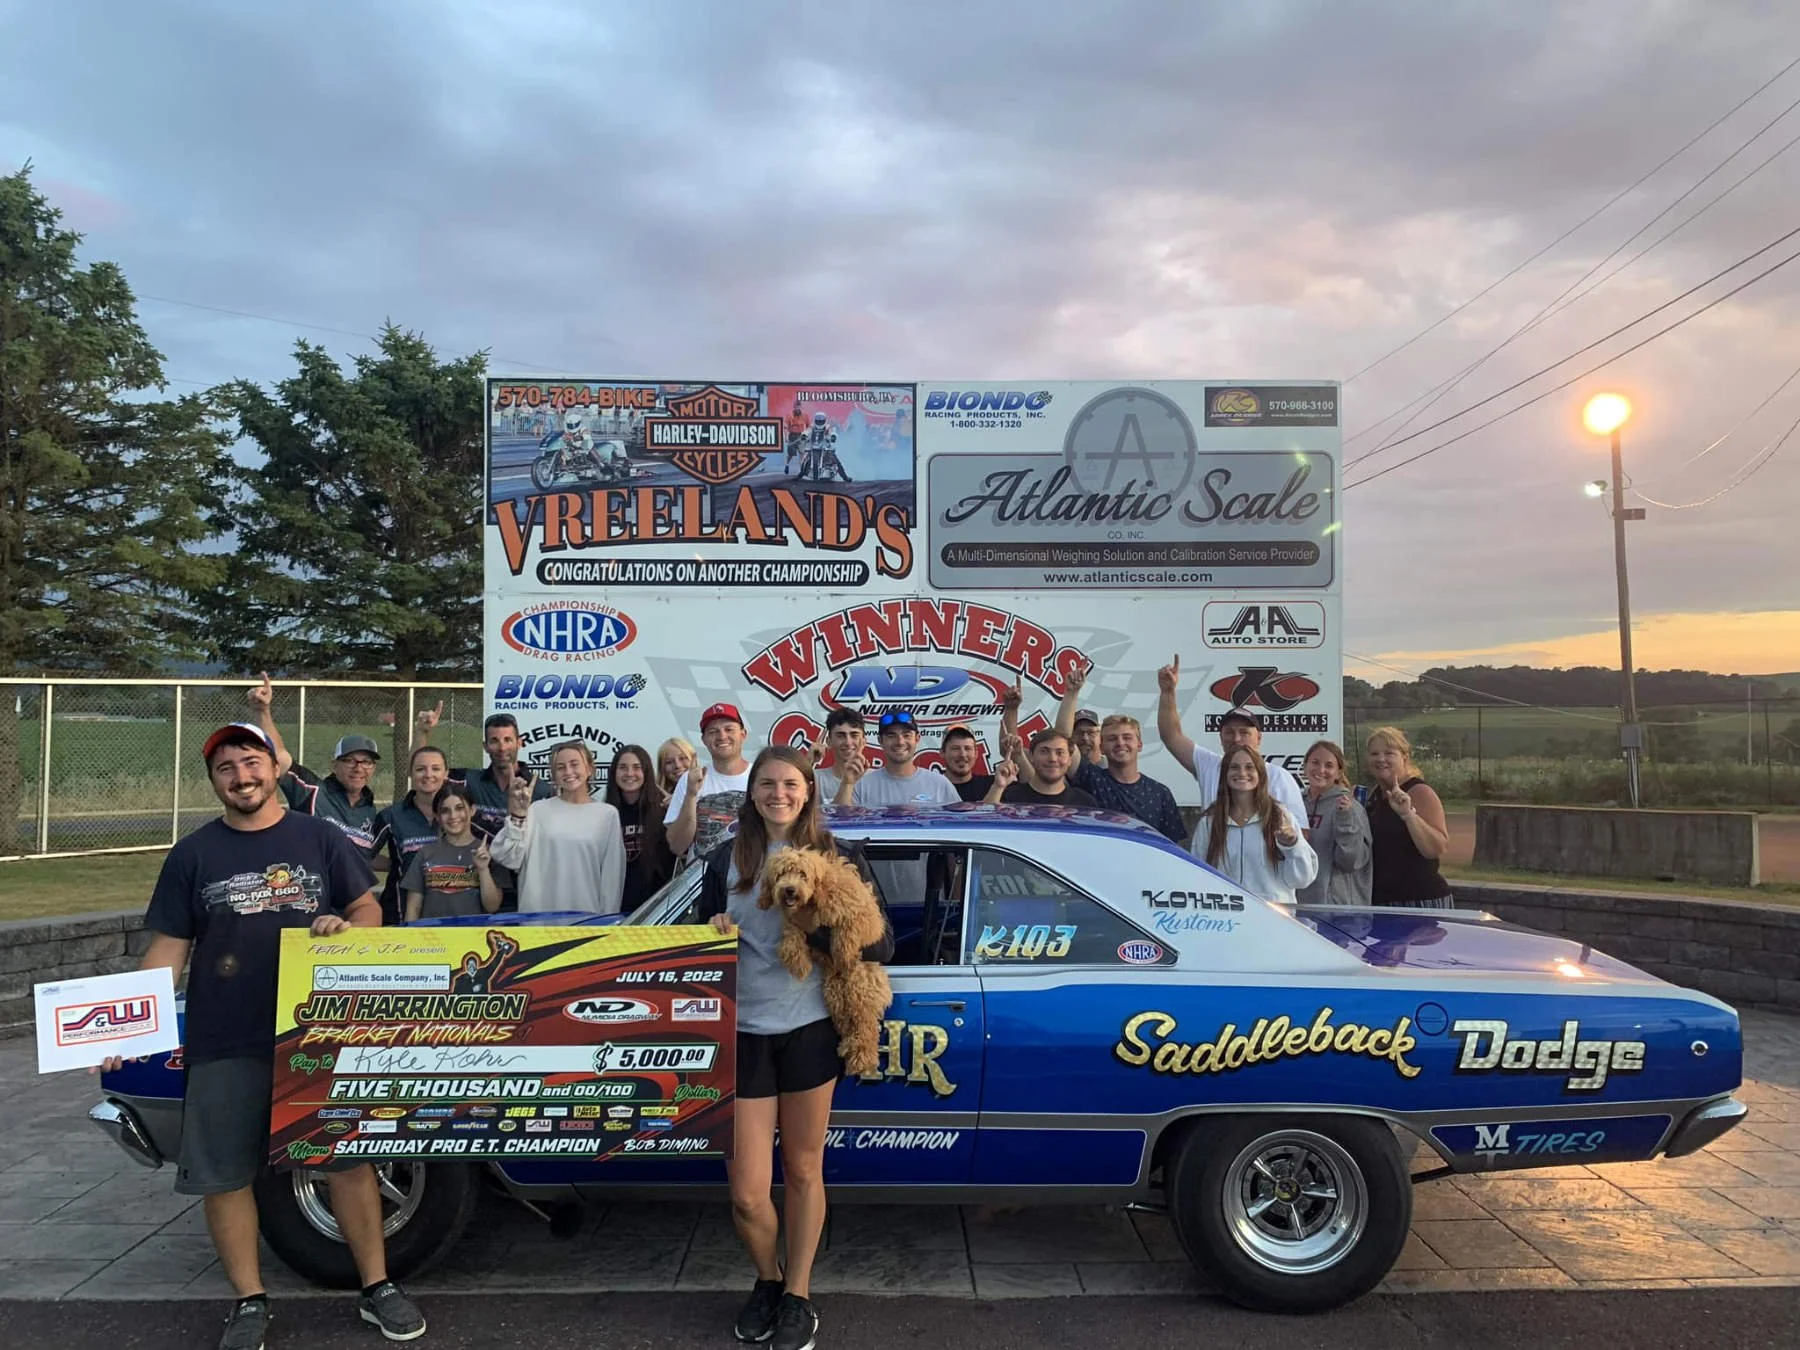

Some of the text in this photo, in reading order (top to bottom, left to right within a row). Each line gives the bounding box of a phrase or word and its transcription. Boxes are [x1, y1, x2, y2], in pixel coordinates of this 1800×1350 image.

[498, 385, 657, 409] 570-784-BIKE
[679, 395, 746, 417] MOTOR
[924, 391, 1048, 411] BIONDO
[924, 411, 1046, 420] RACING PRODUCTS, INC.
[949, 420, 1022, 429] 1-800-332-1320
[652, 424, 777, 445] HARLEY-DAVIDSON
[682, 450, 750, 478] CYCLES
[944, 463, 1321, 524] Atlantic Scale
[491, 484, 915, 580] VREELAND'S
[947, 549, 1315, 564] A Multi-Dimensional Weighing Solution and Calibration Service Provider
[544, 561, 863, 583] CONGRATULATIONS ON ANOTHER CHAMPIONSHIP
[1043, 569, 1214, 584] www.atlanticscale.com
[522, 600, 618, 618] CHAMPIONSHIP
[523, 612, 619, 650] NHRA
[1211, 636, 1308, 645] AUTO STORE
[522, 647, 616, 662] DRAG RACING
[742, 597, 1095, 702] WINNERS
[494, 674, 639, 700] BIONDO
[494, 701, 640, 712] RACING PRODUCTS, INC.
[932, 703, 1006, 716] DRAGWA
[1263, 715, 1328, 726] DESIGNS
[519, 722, 625, 755] REELAND'S
[1152, 910, 1240, 935] Kustoms
[1124, 943, 1157, 961] NHRA
[338, 974, 448, 983] Atlantic Scale Company, Inc.
[616, 971, 724, 984] JULY 16, 2022
[299, 993, 528, 1021] JIM HARRINGTON
[299, 1021, 515, 1048] BRACKET NATIONALS
[1115, 1006, 1423, 1078] Saddleback
[290, 1054, 335, 1075] Pay to
[354, 1047, 426, 1073] Kyle
[595, 1044, 706, 1073] $ 5,000.00
[860, 1019, 958, 1096] HR
[1452, 1019, 1647, 1090] Dodge
[330, 1079, 634, 1098] FIVE THOUSAND and 00/100
[674, 1085, 721, 1101] Dollars
[504, 1107, 537, 1118] JEGS
[288, 1140, 332, 1159] Memo
[333, 1138, 601, 1155] SATURDAY PRO E.T. CHAMPION
[623, 1137, 710, 1153] BOB DIMINO
[855, 1129, 960, 1150] CHAMPION
[1514, 1130, 1607, 1156] TIRES
